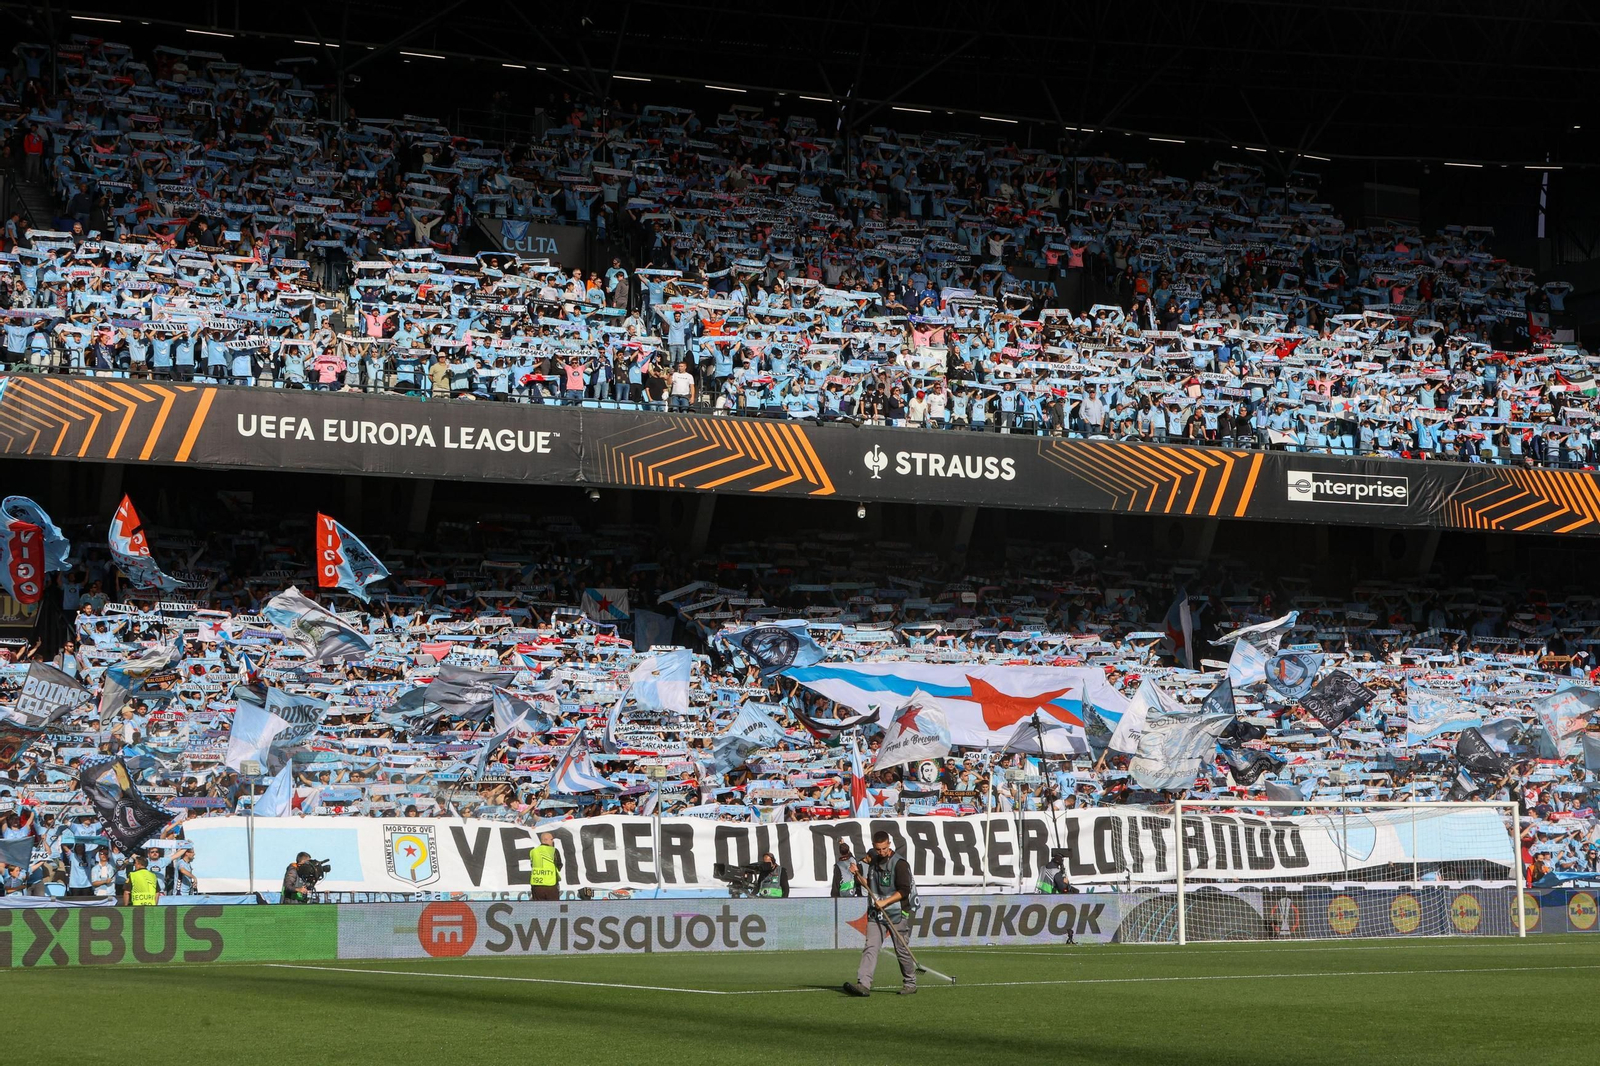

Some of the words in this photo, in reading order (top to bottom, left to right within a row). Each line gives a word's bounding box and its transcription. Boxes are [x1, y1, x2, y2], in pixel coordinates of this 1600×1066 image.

[502, 236, 559, 255] CELTA
[208, 321, 242, 330] COMAND
[237, 413, 315, 441] UEFA
[323, 418, 437, 448] EUROPA
[444, 425, 552, 454] LEAGUE
[895, 451, 1016, 481] STRAUSS
[1290, 478, 1407, 500] enterprise
[324, 518, 336, 577] VIGO
[22, 675, 90, 704] BOINAS
[269, 704, 324, 723] BOINAS
[272, 722, 318, 741] ELESTES
[1066, 778, 1076, 788] 12
[385, 838, 395, 873] DENANTES
[429, 837, 438, 874] ESCRAVOS
[449, 823, 700, 887] VENCER
[714, 823, 794, 881] OU
[1065, 815, 1310, 875] LOITANDO
[532, 868, 554, 876] CURITY
[132, 893, 156, 901] SECURI
[1511, 906, 1539, 917] LDL
[1570, 904, 1596, 916] LIDL
[485, 903, 767, 953] Swissquote
